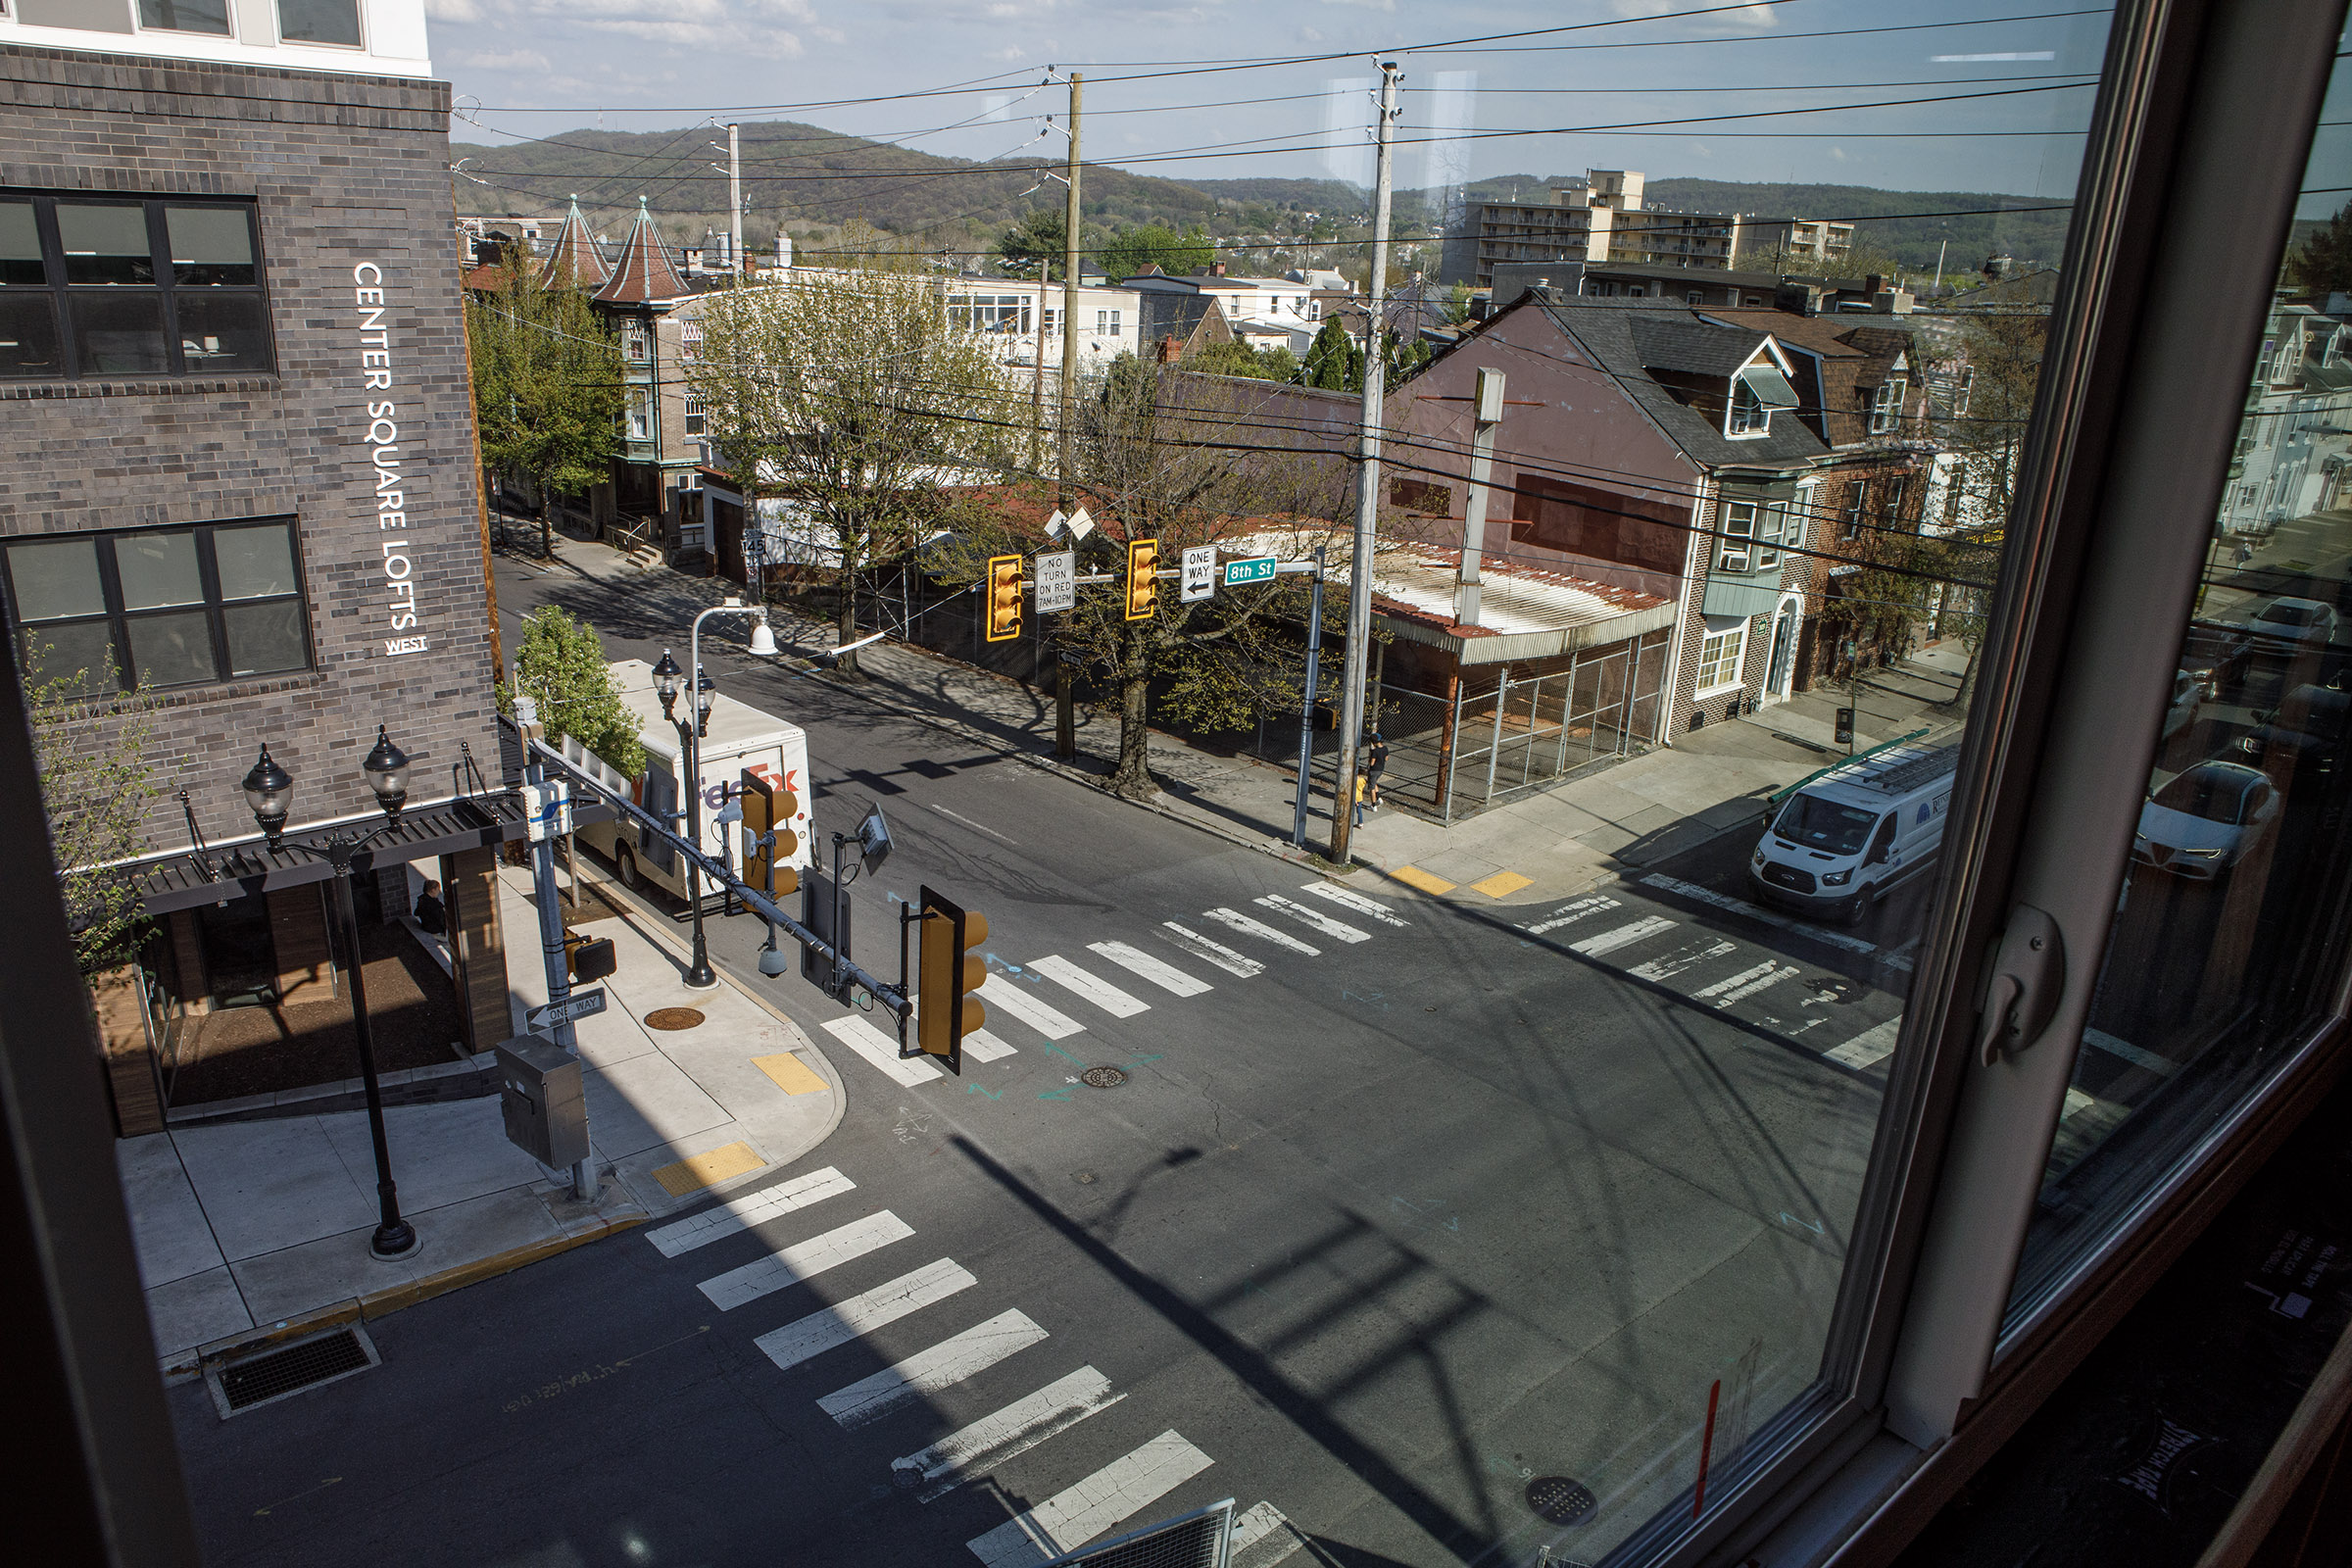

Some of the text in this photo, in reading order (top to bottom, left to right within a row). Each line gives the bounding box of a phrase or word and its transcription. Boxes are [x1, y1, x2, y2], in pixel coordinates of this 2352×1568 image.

[354, 262, 416, 631] CENTER SQUARE LOFTS
[742, 539, 764, 552] 145
[1048, 558, 1062, 568] NO
[1189, 551, 1209, 564] ONE
[1044, 570, 1066, 581] TURN
[1189, 565, 1209, 579] WAY
[1231, 563, 1271, 579] 8th St
[1040, 581, 1071, 595] ON RED
[1039, 594, 1071, 607] 7AM-10PM
[385, 636, 427, 654] WEST
[550, 997, 597, 1019] ONE WAY
[2117, 1418, 2202, 1500] STRETCH TAPE
